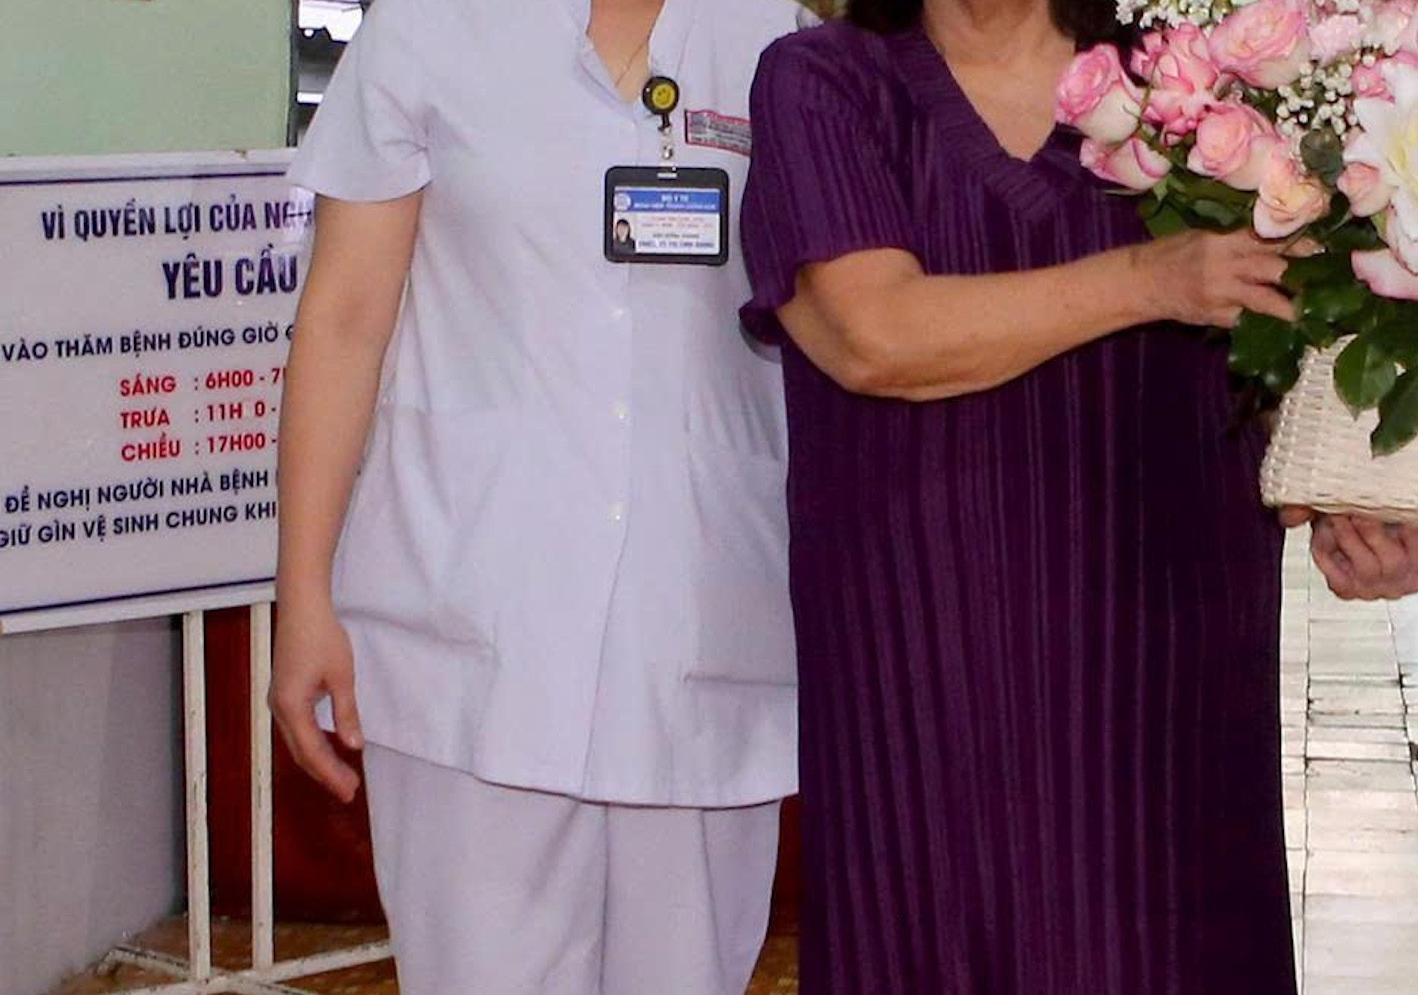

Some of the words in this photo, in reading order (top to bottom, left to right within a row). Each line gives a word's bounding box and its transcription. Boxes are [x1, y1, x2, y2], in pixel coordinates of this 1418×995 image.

[42, 204, 65, 240] VÌ
[74, 198, 156, 242] QUYỀN
[164, 202, 200, 240] LỢI
[209, 193, 257, 232] CỦA
[162, 252, 223, 300] YÊU
[235, 243, 297, 295] CẦU
[2, 337, 48, 361] VÀO
[55, 333, 113, 358] THĂM
[120, 329, 171, 357] BỆNH
[178, 326, 235, 349] ĐÚNG
[242, 320, 279, 344] GIỜ
[120, 373, 177, 397] SÁNG
[205, 370, 254, 389] 6H00
[120, 406, 170, 428] TRƯA
[121, 432, 181, 462] CHIỀU
[207, 432, 266, 453] 17H00
[5, 485, 31, 513] ĐỀ
[38, 489, 90, 511] NGHỊ
[98, 477, 164, 504] NGƯỜI
[171, 470, 213, 496] NHÀ
[220, 468, 268, 495] BỆNH
[0, 524, 31, 548] GIỮ
[38, 520, 75, 542] GÌN
[83, 515, 107, 542] VỆ
[113, 513, 158, 535] SINH
[166, 505, 238, 528] CHUNG
